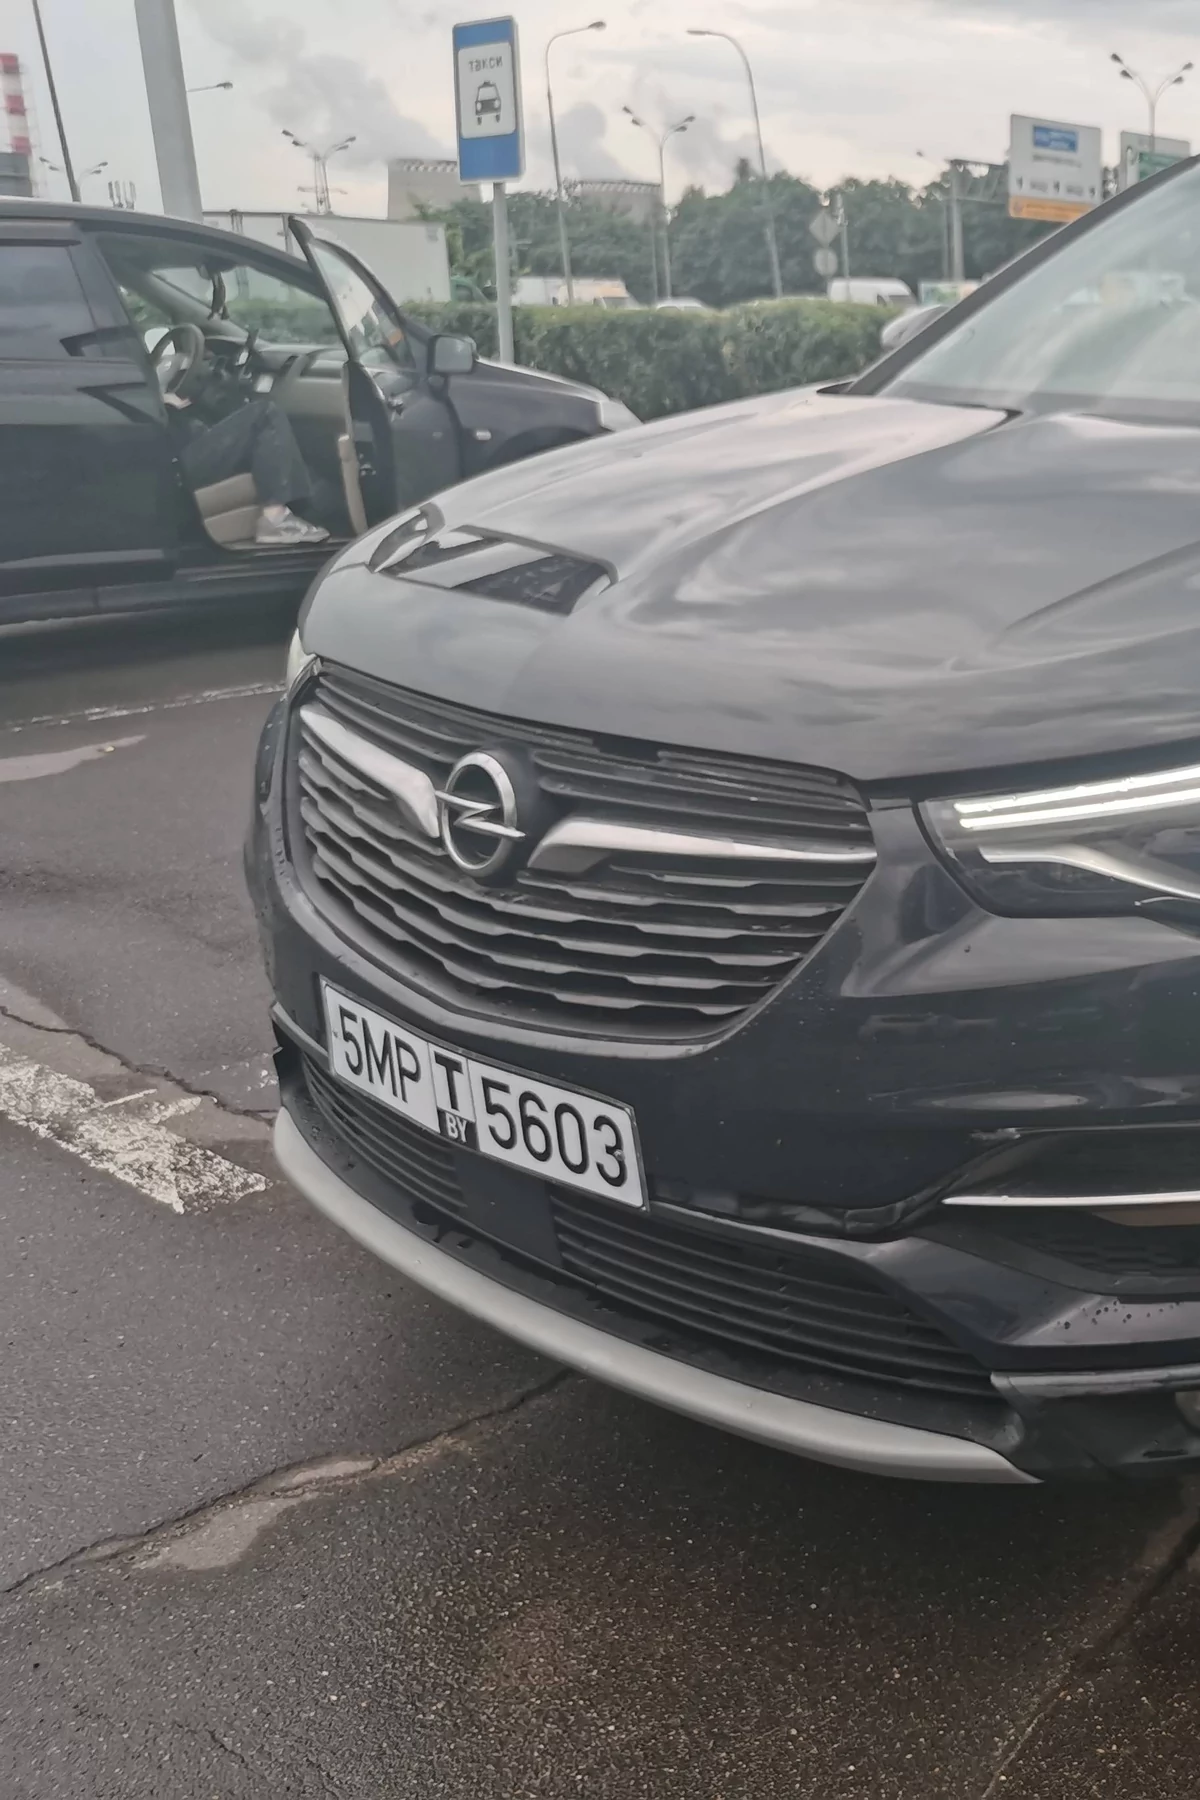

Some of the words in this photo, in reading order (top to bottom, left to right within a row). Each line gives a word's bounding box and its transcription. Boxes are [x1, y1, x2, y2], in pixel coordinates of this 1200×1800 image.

[338, 1004, 422, 1104] 5MP
[435, 1051, 464, 1112] T
[481, 1076, 628, 1187] 5603
[445, 1112, 468, 1143] BY
